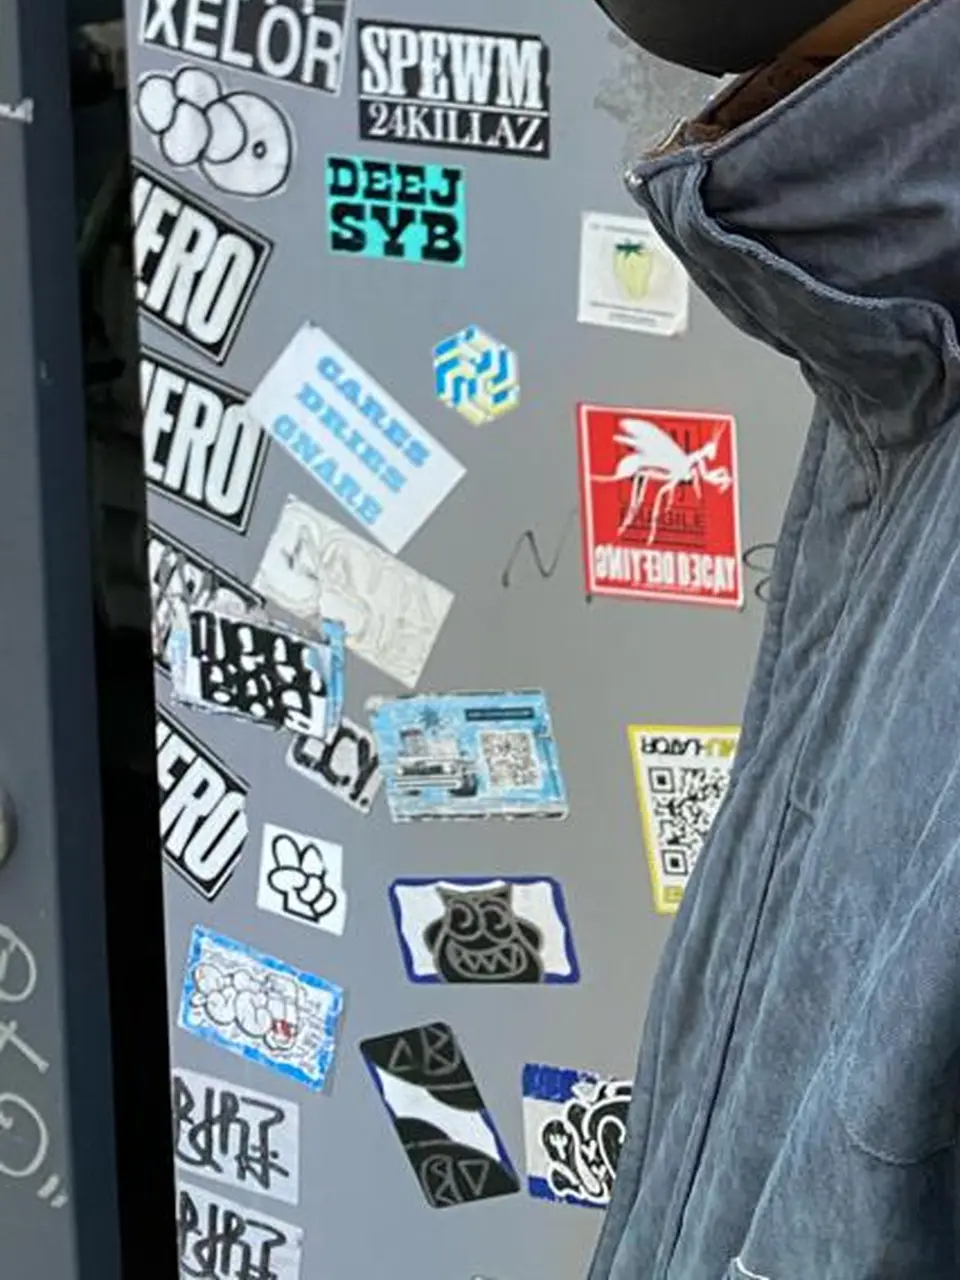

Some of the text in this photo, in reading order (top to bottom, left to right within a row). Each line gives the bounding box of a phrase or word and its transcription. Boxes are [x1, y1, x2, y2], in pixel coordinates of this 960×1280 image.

[360, 24, 545, 110] SPEWM
[368, 103, 546, 152] 24KILLAZ
[328, 157, 461, 208] DEEJ
[330, 204, 462, 263] SYB
